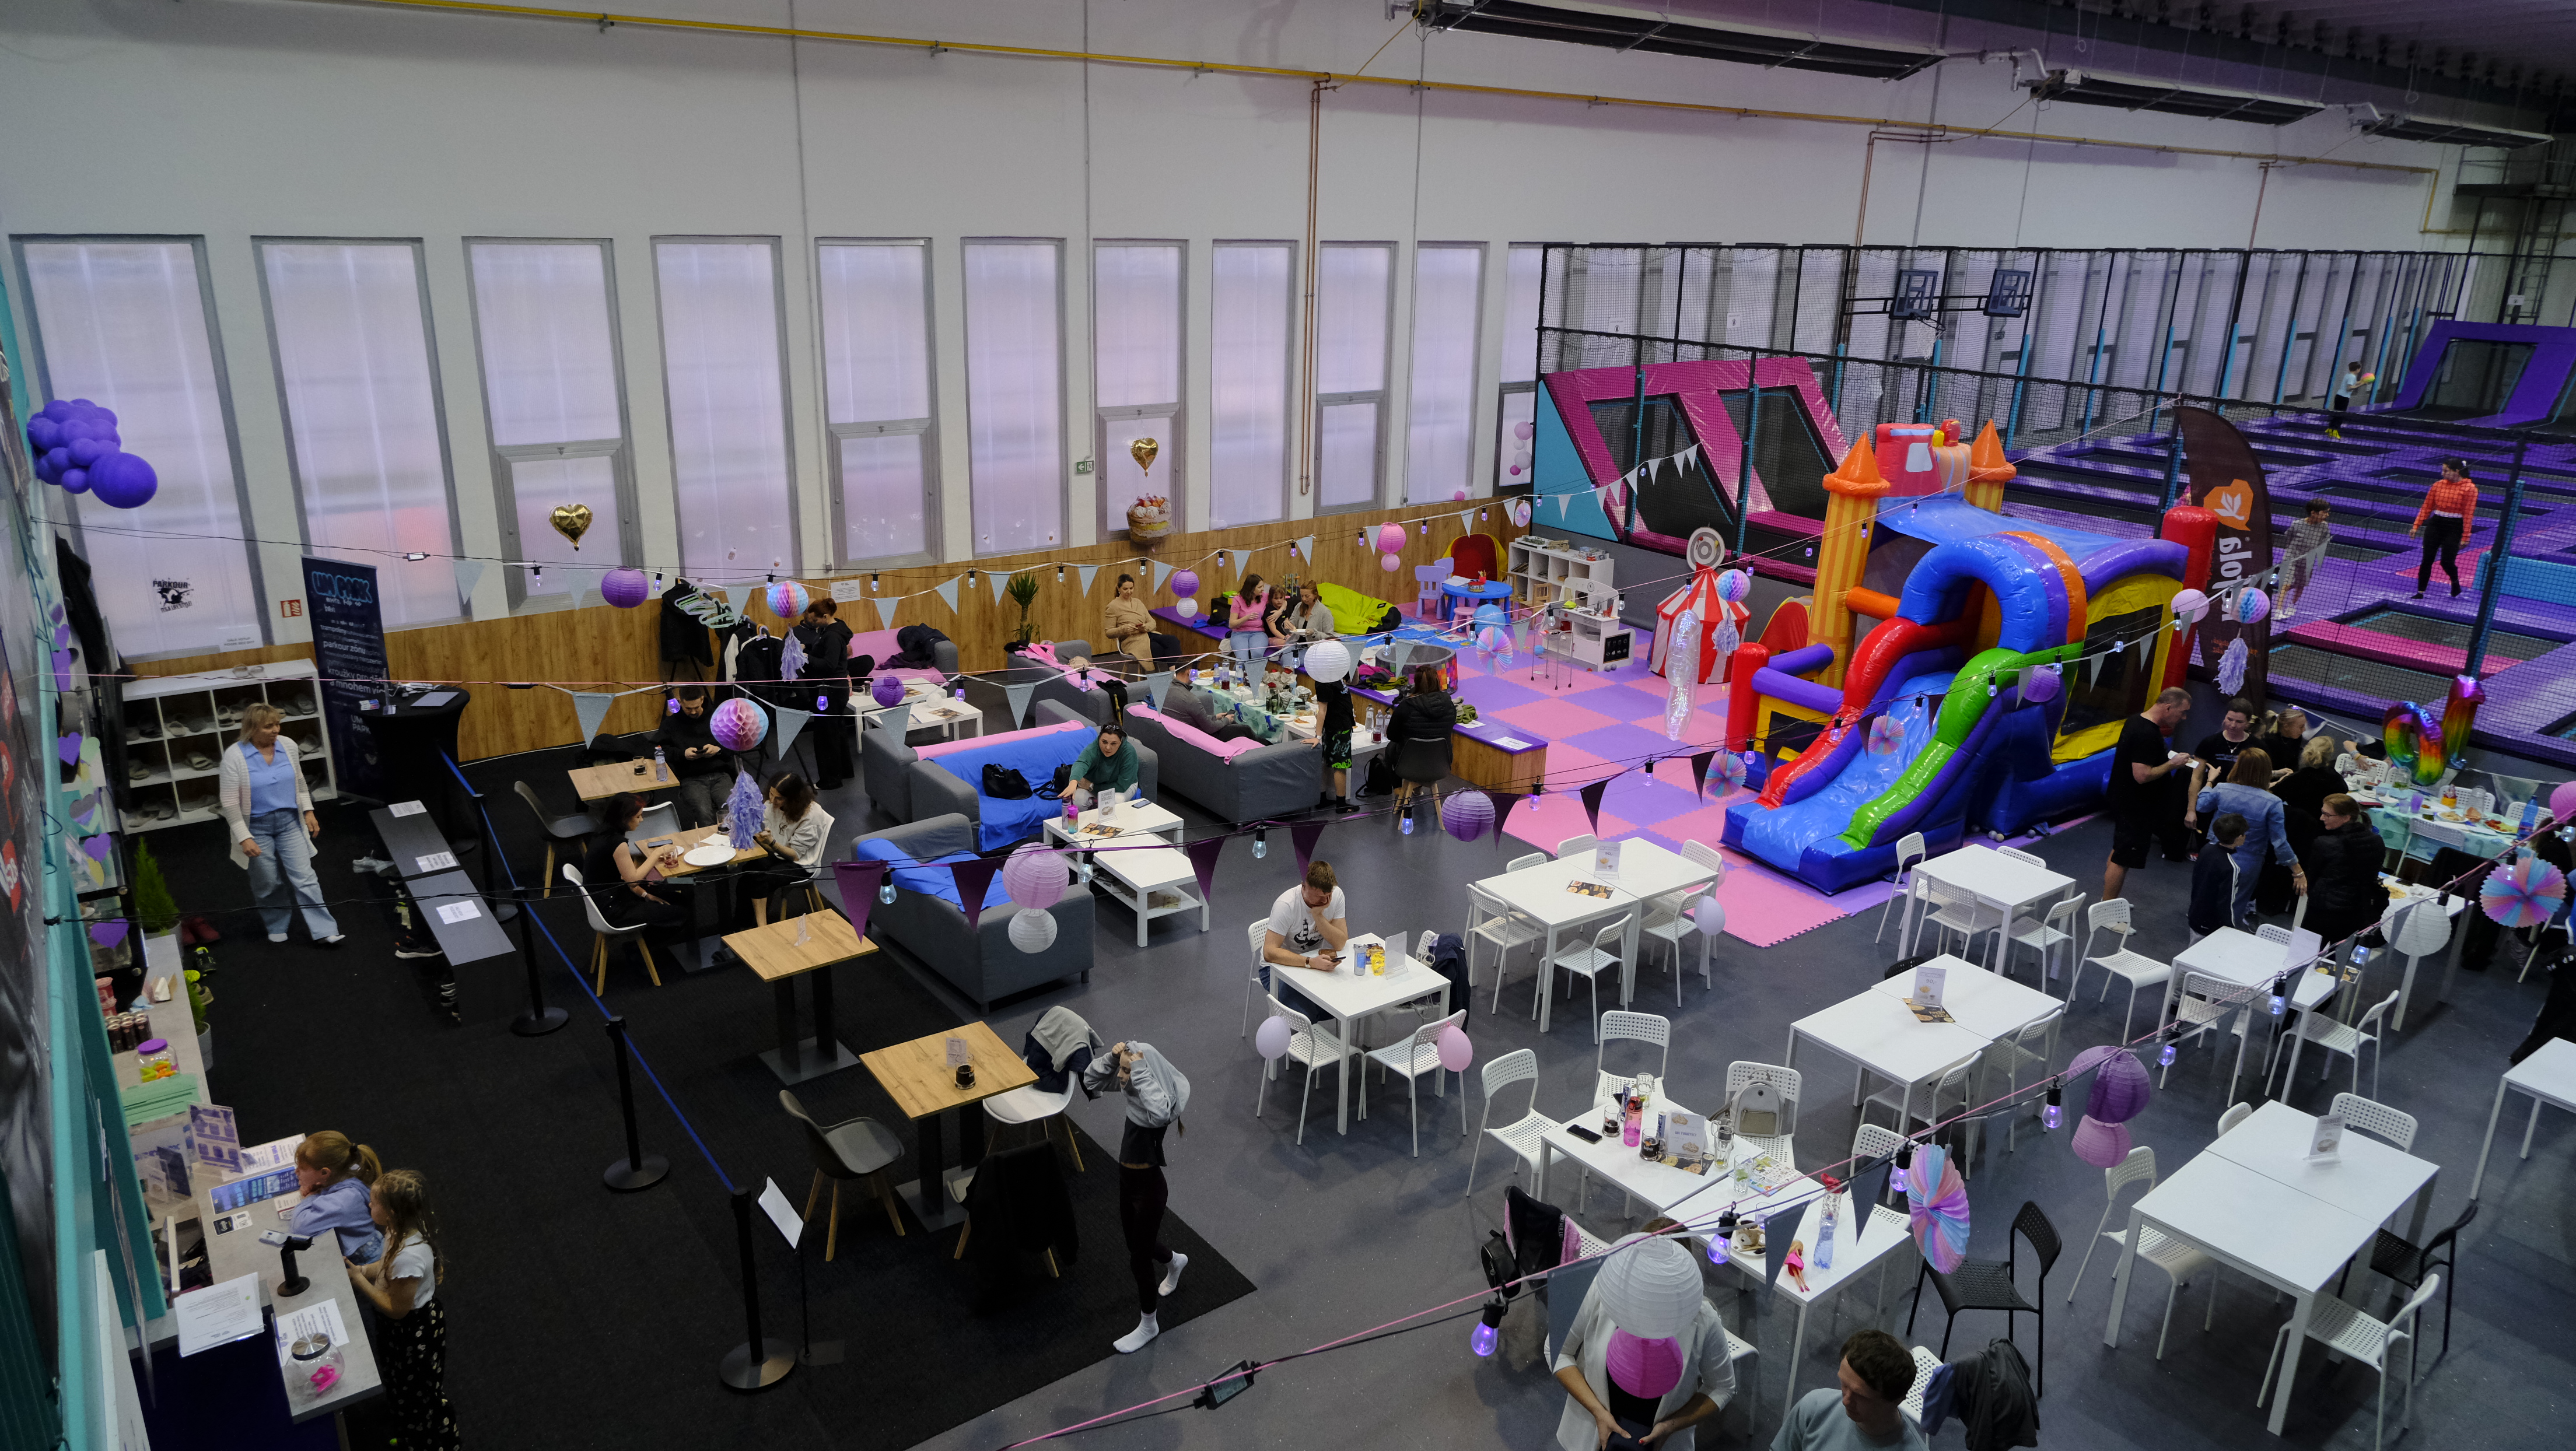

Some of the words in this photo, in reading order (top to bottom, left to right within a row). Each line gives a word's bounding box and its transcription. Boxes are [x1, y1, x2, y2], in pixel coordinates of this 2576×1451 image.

[153, 580, 188, 589] PARKOUR
[323, 641, 349, 651] parkour
[350, 644, 366, 654] zónu
[327, 666, 355, 679] kroužky
[336, 680, 372, 693] mnohem
[351, 714, 363, 723] UM
[352, 723, 372, 735] PARK
